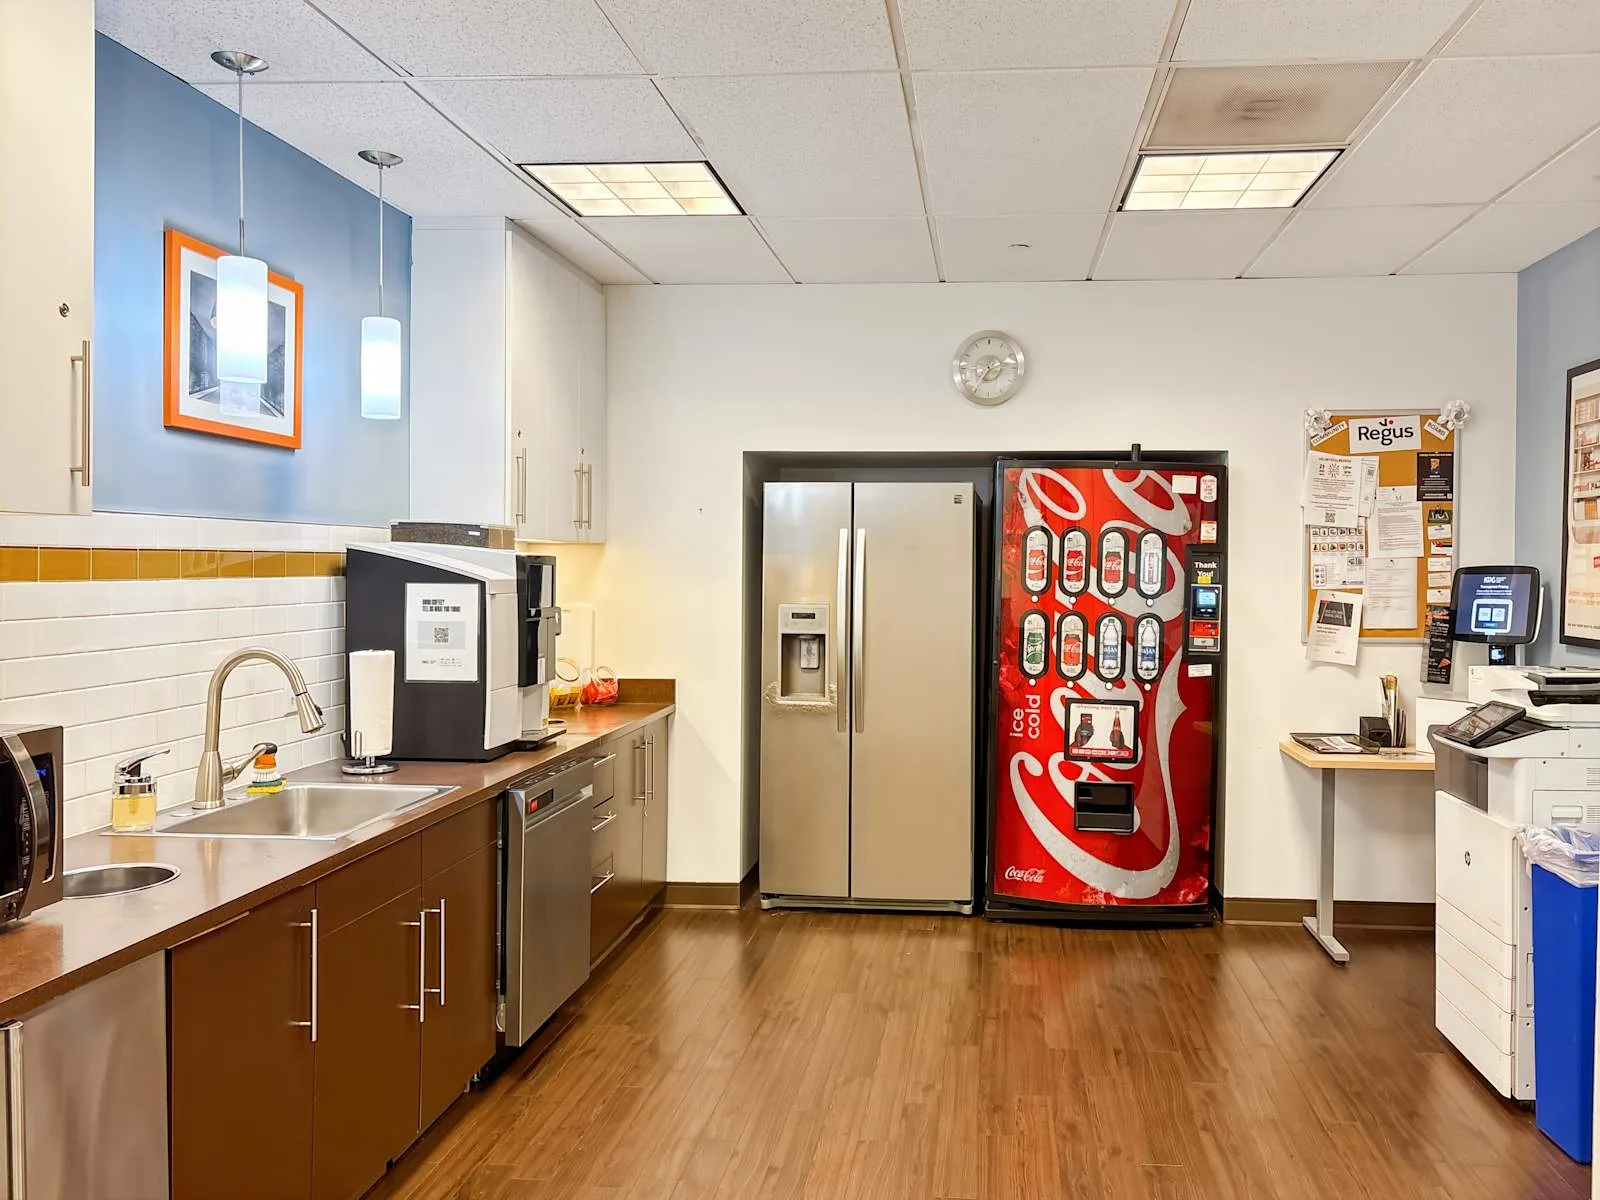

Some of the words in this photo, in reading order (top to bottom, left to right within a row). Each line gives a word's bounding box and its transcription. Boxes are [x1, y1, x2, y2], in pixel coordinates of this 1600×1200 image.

[1358, 426, 1414, 446] Regus
[1194, 561, 1217, 569] Thank
[1009, 708, 1024, 737] ice
[1025, 694, 1041, 739] cold
[1005, 866, 1045, 883] Coca-Cola
